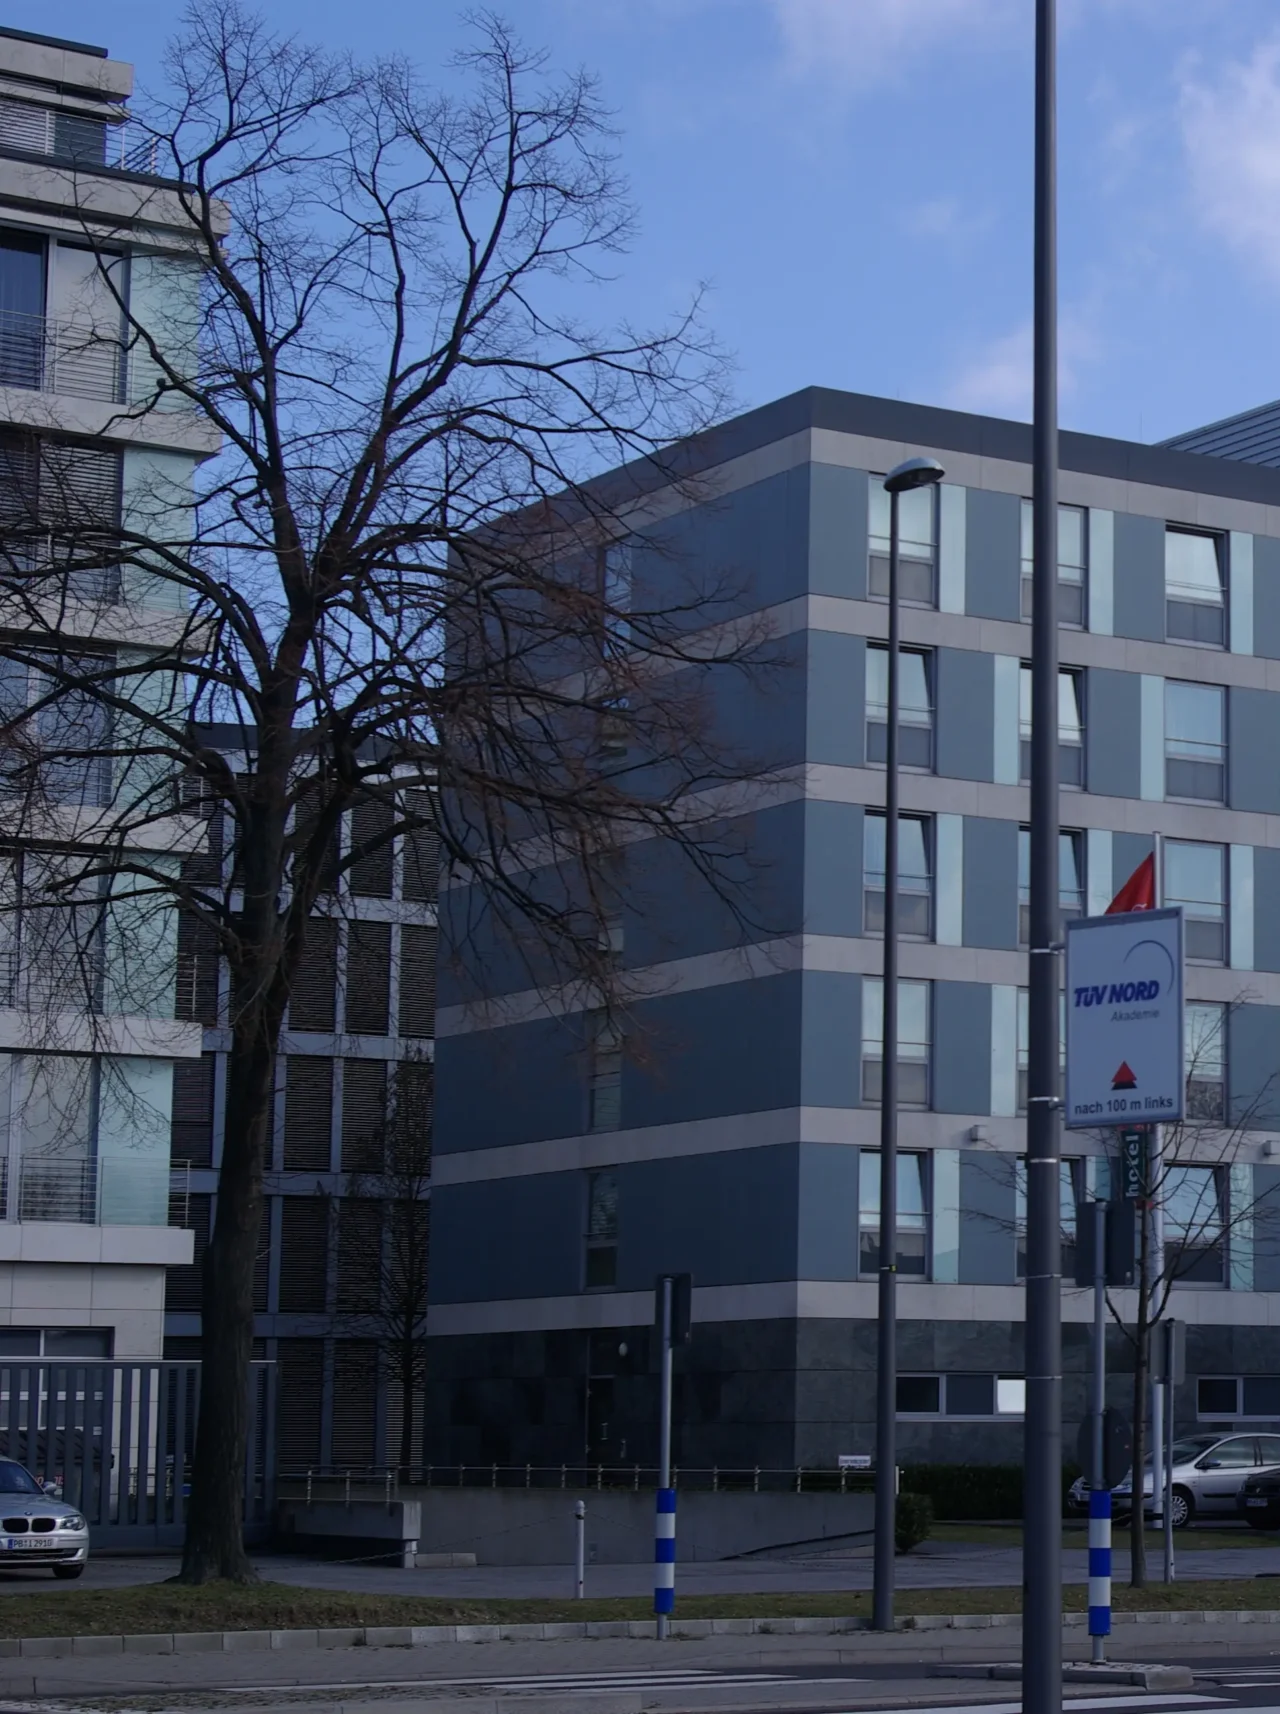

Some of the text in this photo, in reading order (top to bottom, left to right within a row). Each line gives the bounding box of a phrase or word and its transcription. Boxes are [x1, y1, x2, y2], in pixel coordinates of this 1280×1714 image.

[1074, 979, 1160, 1008] TÜV NORD
[1111, 1009, 1160, 1022] Akademie
[1074, 1095, 1174, 1115] nach 100 m links
[1125, 1134, 1140, 1197] hotel
